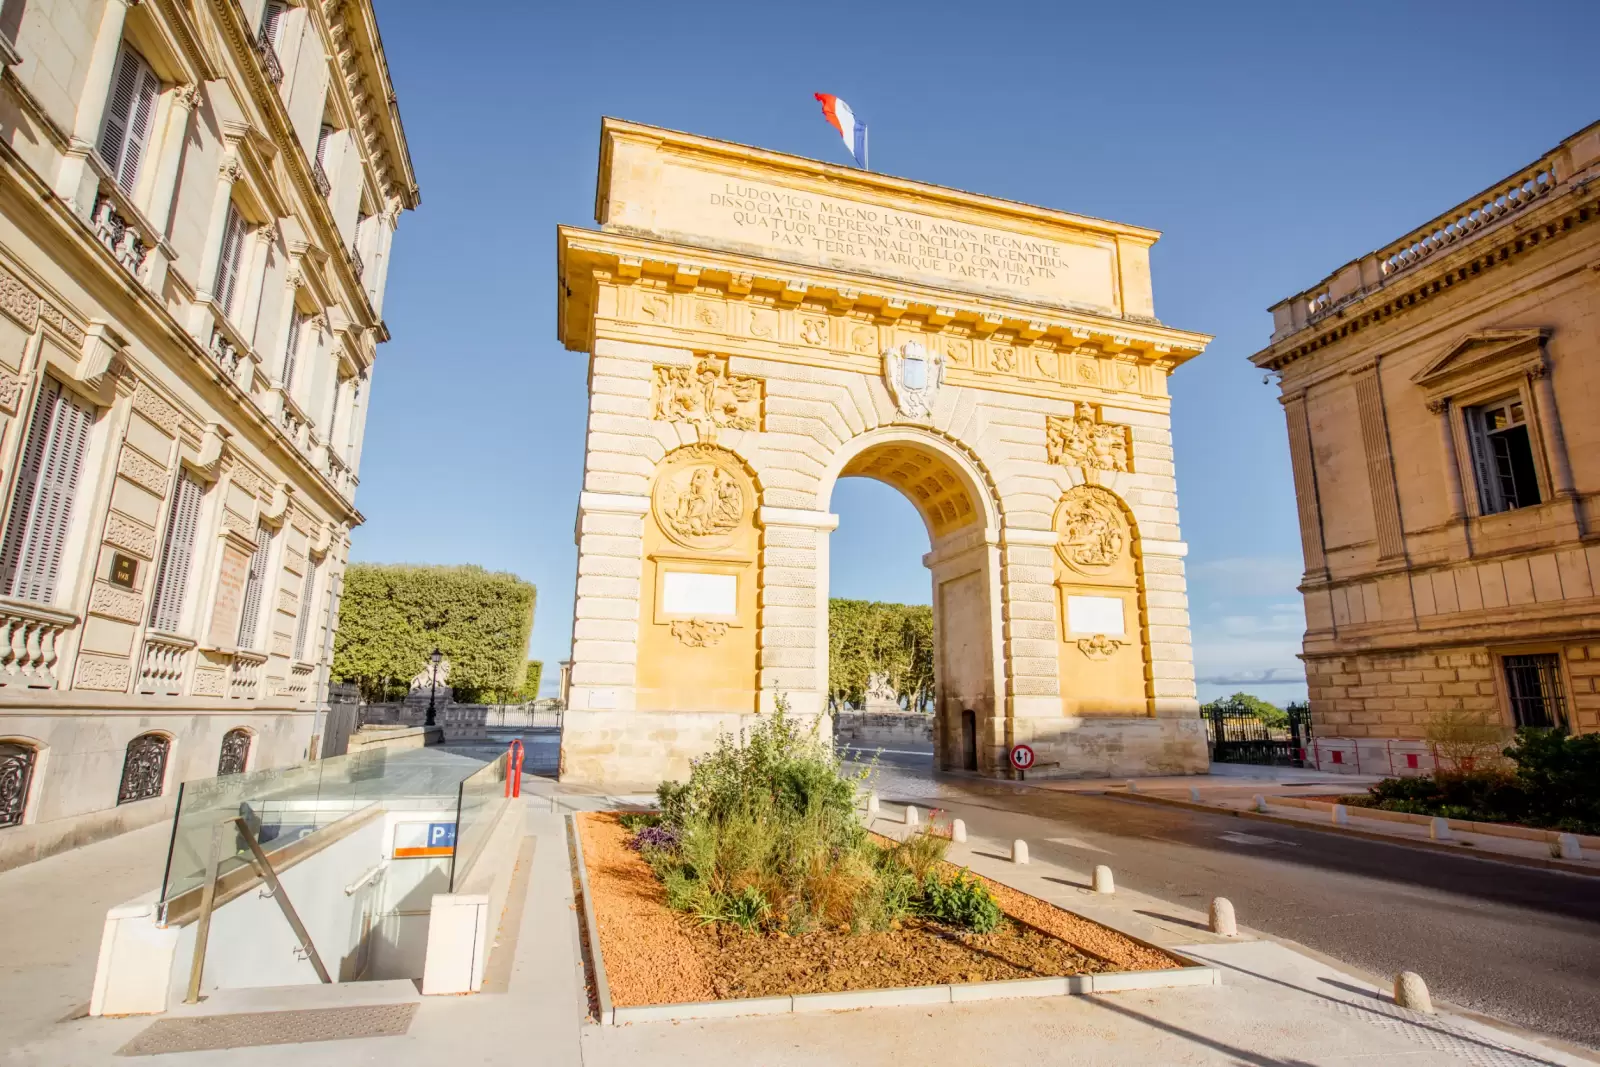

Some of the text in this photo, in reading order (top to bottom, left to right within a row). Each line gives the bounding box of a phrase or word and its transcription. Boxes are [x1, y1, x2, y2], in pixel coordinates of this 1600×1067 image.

[710, 193, 1070, 268] DISSOCIATIS REPRESSIS CONCILIATIS GENTIBUS
[725, 183, 1061, 257] LUDOVICO MAGNO LXXII ANNOS REGNANTE
[733, 211, 1056, 278] QUATUOR DECENNALI BELLO CONJURATIS
[771, 230, 1031, 286] PAX TERRA MARIQUE PARTA 1715
[432, 826, 445, 844] P
